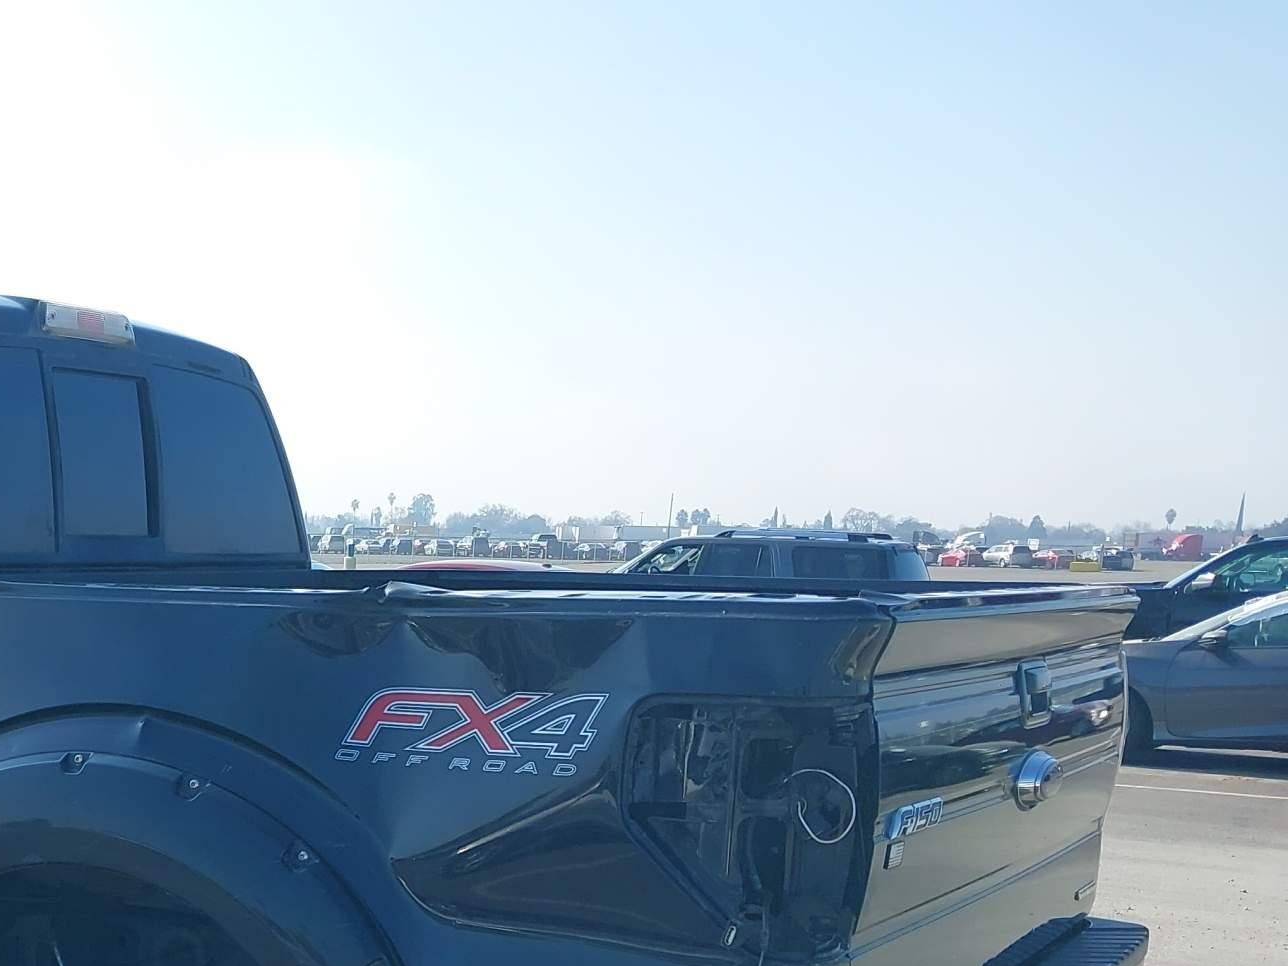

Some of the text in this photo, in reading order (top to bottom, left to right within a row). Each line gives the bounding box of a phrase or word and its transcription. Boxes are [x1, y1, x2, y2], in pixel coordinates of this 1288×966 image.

[341, 687, 609, 759] FX4
[334, 748, 577, 776] OFF ROAD
